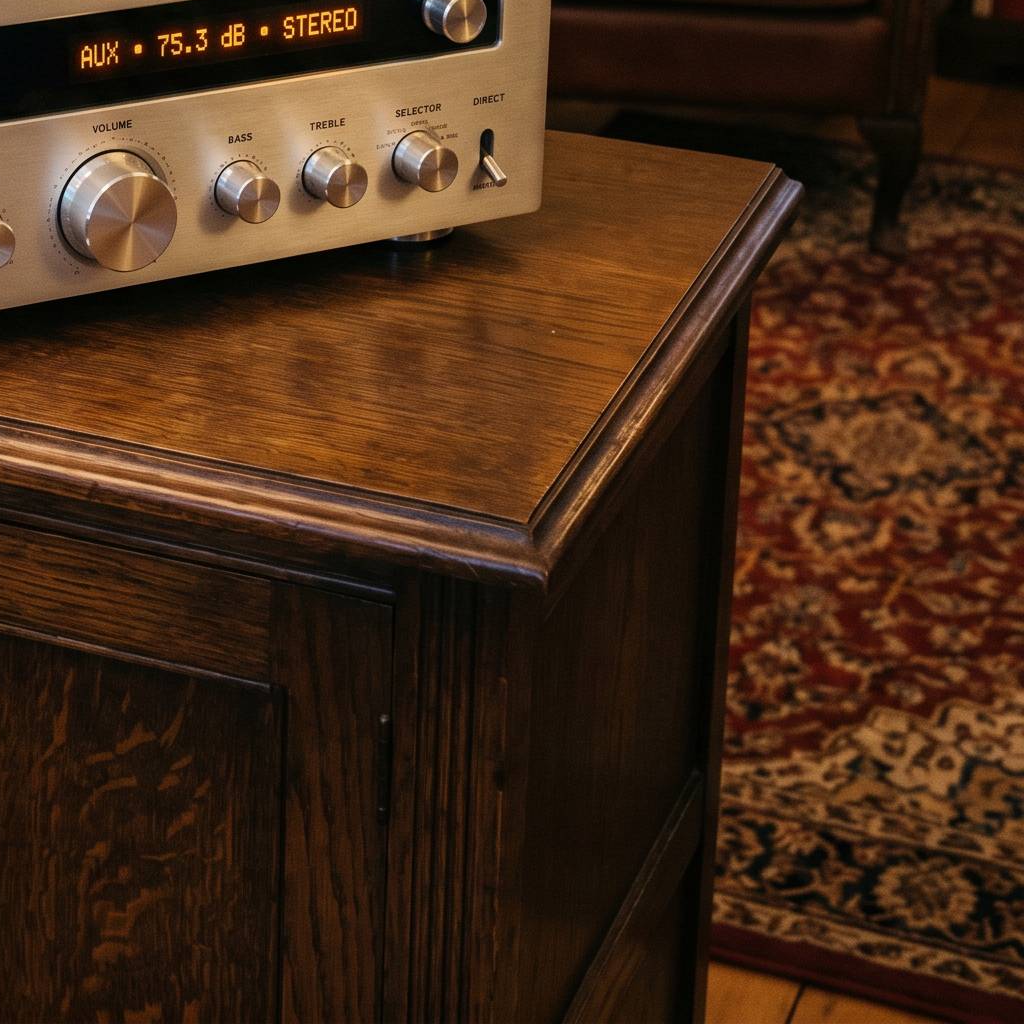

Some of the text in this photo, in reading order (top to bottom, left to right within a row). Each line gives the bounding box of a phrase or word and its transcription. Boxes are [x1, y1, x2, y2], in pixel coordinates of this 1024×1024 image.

[81, 7, 357, 69] AUX 75.3 dB STEREO
[473, 93, 506, 106] DIRECT
[395, 103, 442, 118] SELECTOR
[92, 119, 133, 133] VOLUME
[309, 117, 346, 131] TREBLE
[228, 132, 253, 144] BASS
